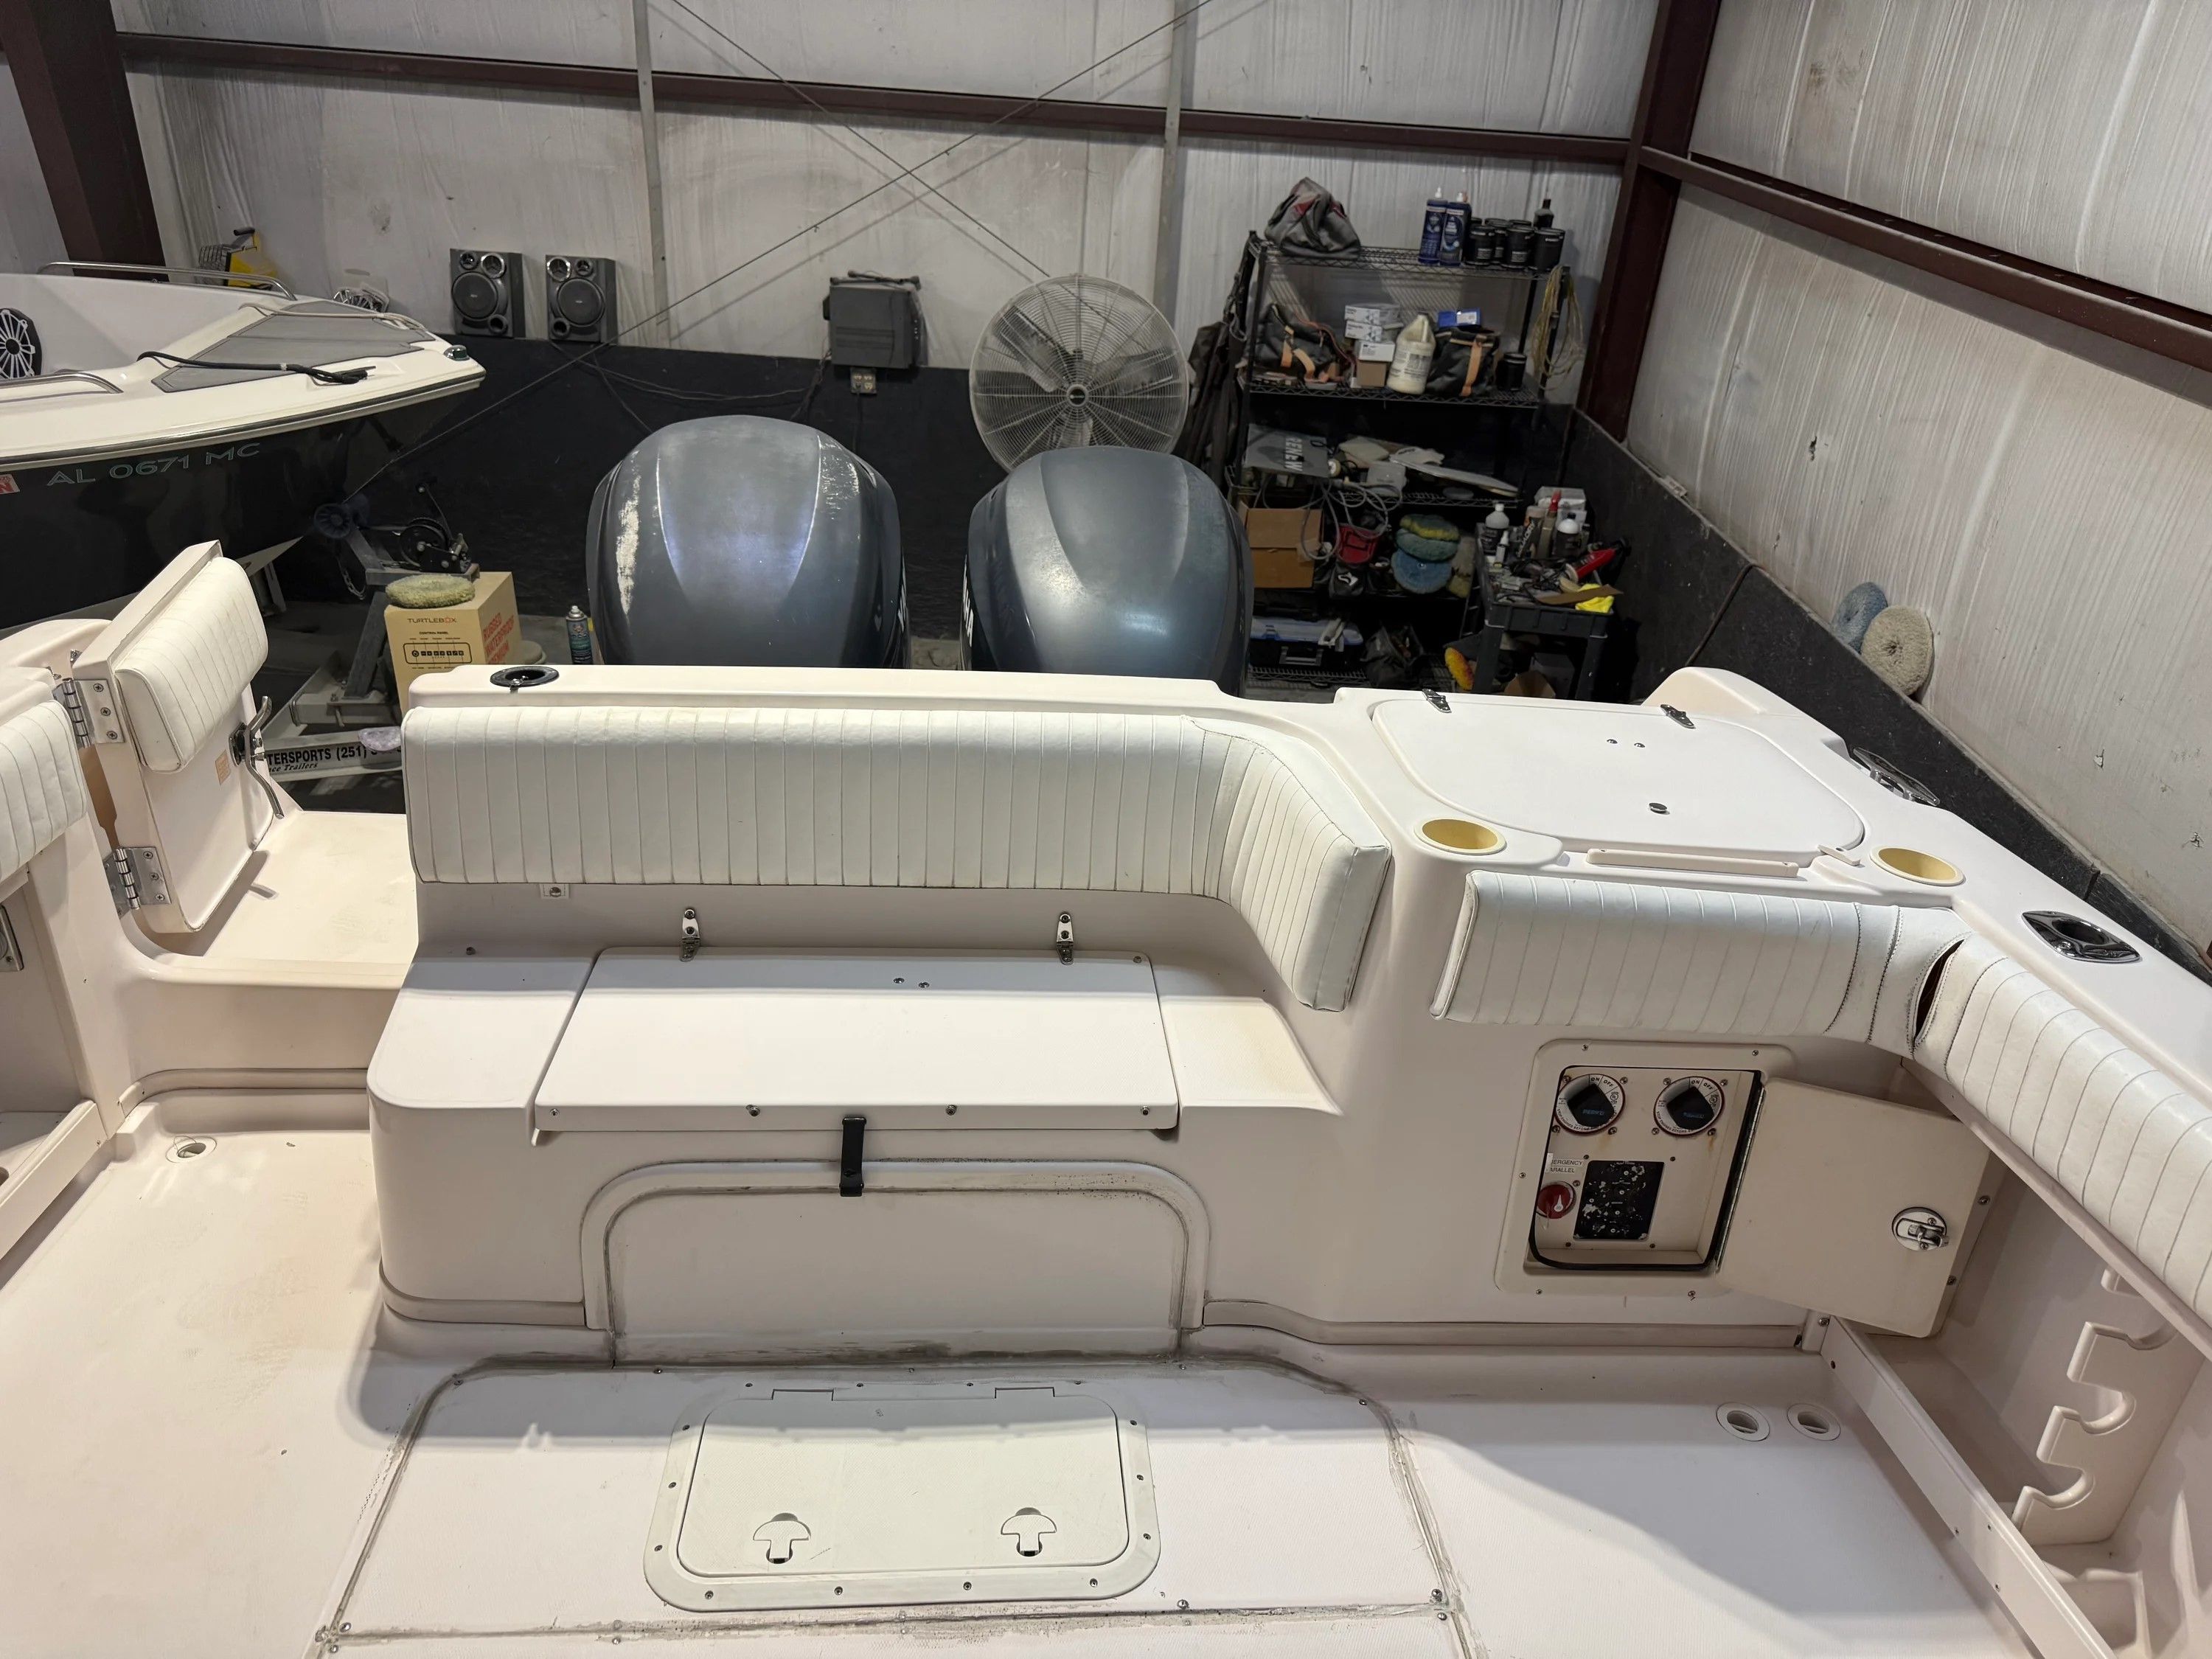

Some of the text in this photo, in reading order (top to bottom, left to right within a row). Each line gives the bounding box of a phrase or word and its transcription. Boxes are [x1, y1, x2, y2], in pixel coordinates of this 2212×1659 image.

[47, 442, 260, 486] AL 0671 MC
[284, 762, 318, 772] Trailers
